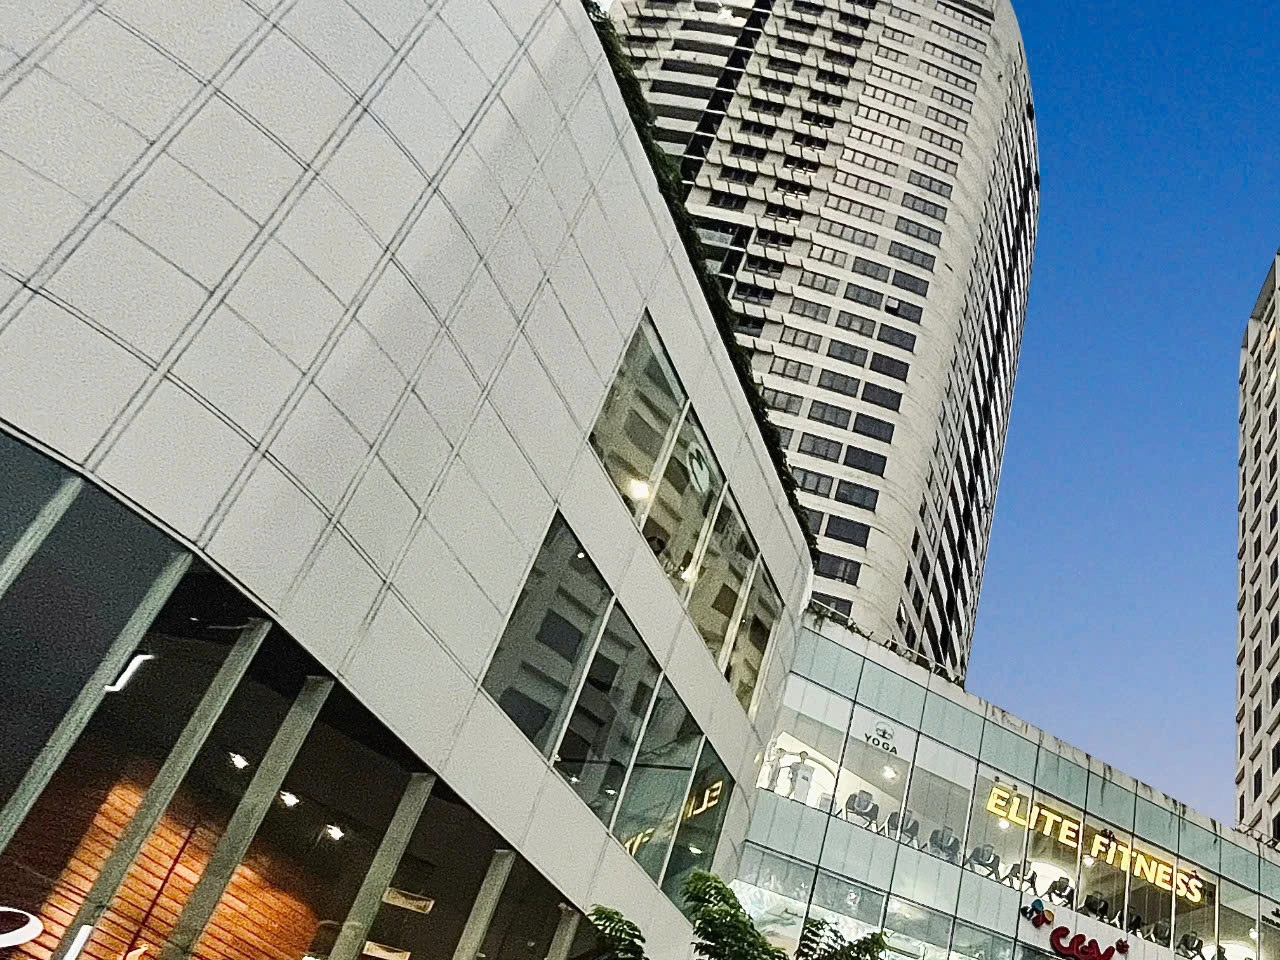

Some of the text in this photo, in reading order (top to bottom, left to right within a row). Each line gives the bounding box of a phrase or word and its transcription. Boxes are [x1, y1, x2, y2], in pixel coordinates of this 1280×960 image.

[864, 733, 898, 755] YOGA
[985, 786, 1204, 903] ELITE FITNESS
